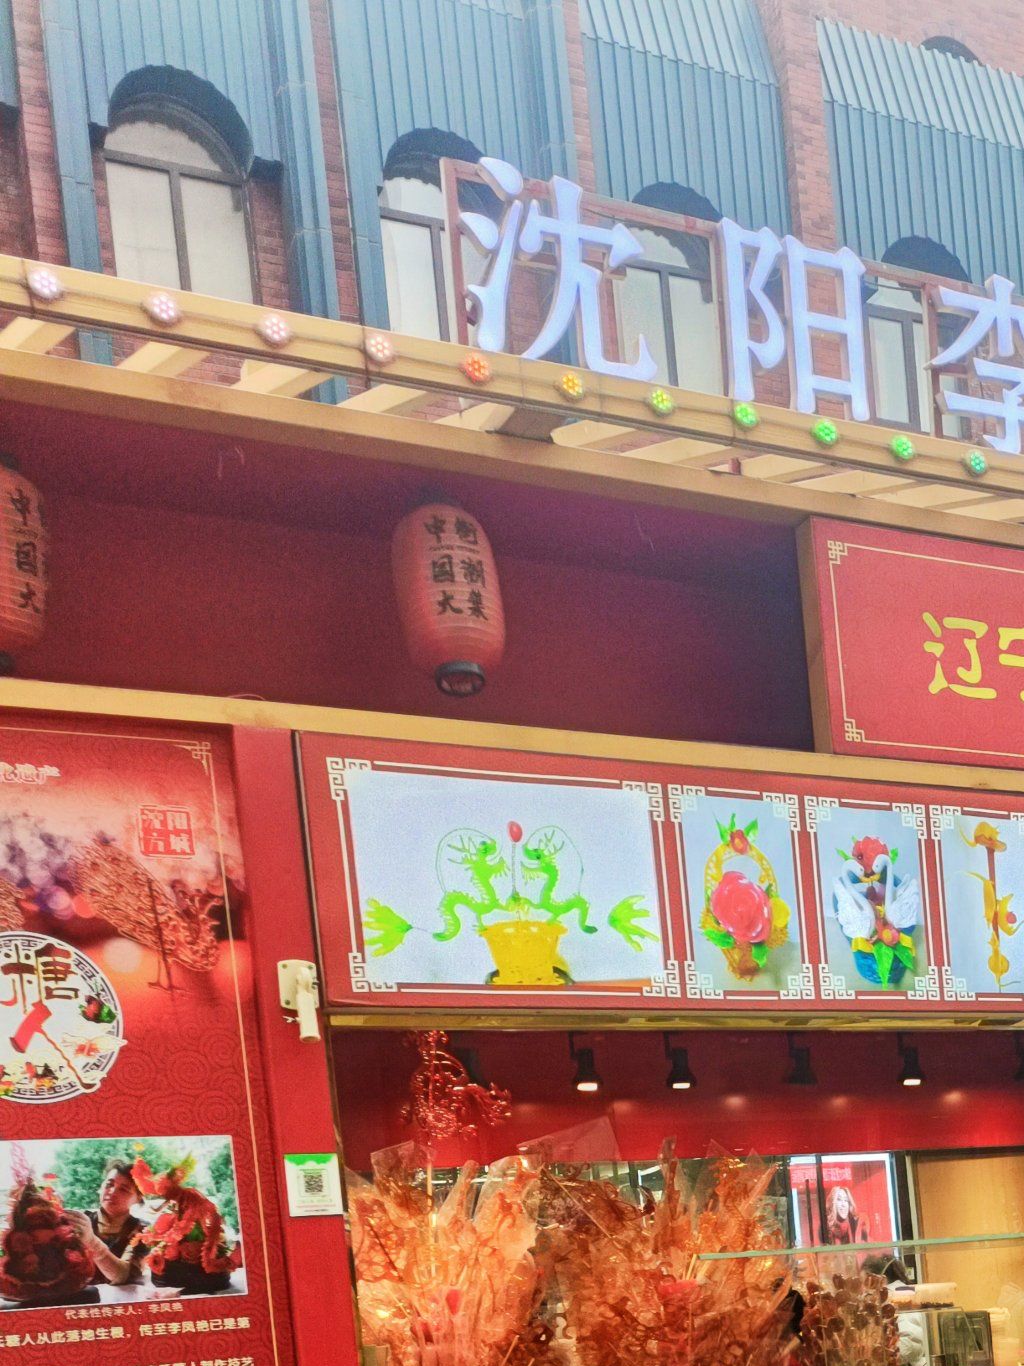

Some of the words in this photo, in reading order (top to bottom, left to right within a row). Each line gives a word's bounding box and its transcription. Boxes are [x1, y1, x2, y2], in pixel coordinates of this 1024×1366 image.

[0, 1317, 250, 1348] 糖人从此落地生根，传至李凤艳已是第
